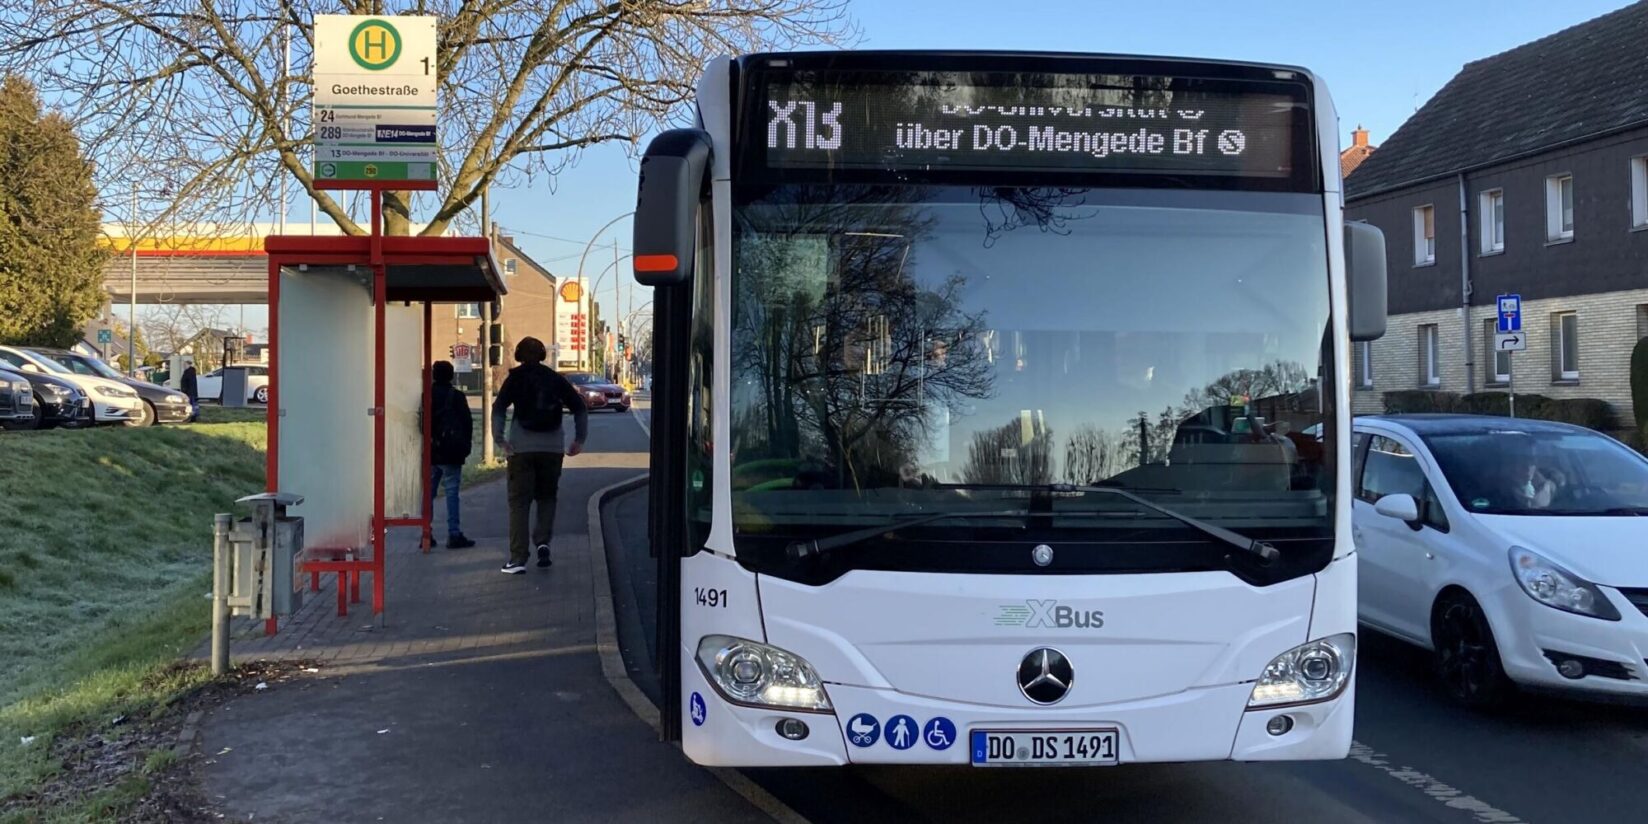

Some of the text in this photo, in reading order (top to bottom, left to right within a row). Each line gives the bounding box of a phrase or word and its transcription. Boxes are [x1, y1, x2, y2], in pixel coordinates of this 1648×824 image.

[364, 30, 386, 59] H
[420, 57, 429, 75] 1
[331, 84, 419, 96] Goethestraße
[321, 110, 334, 122] 24
[321, 126, 341, 139] 289
[896, 122, 964, 150] über
[973, 124, 1165, 157] DO-Mengede
[1172, 128, 1209, 154] Bf
[331, 149, 341, 158] 13
[694, 586, 728, 608] 1491
[1024, 599, 1104, 628] XBus
[977, 750, 983, 758] D
[988, 735, 1114, 760] DO DS 1491
